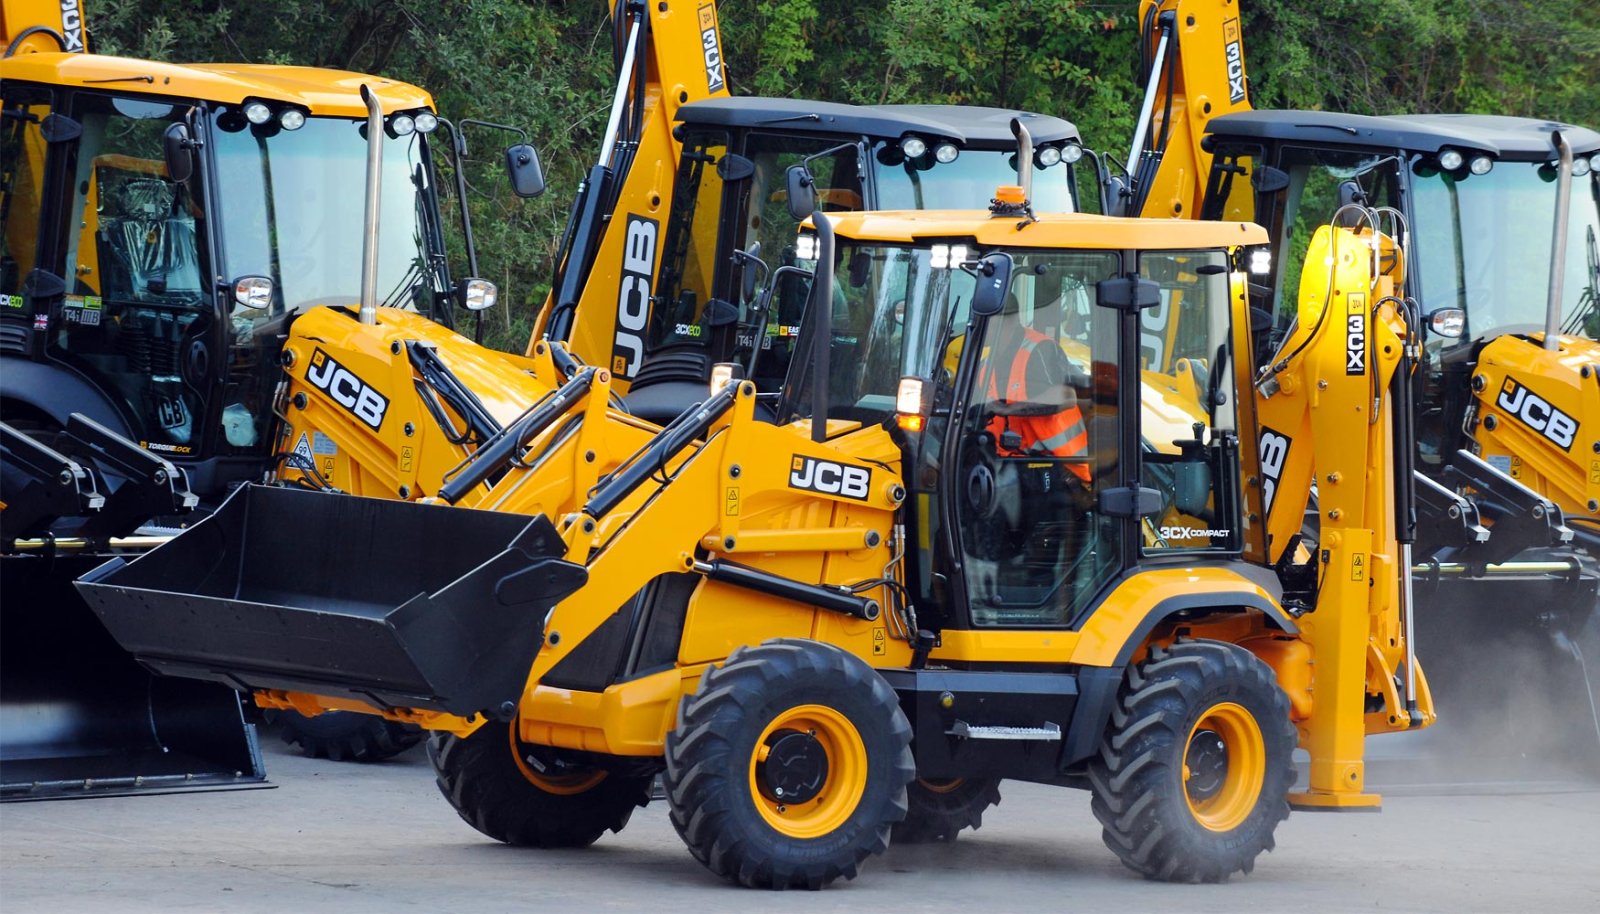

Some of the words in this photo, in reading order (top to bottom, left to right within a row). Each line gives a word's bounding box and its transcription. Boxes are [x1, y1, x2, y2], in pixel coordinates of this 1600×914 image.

[702, 28, 723, 86] 3CX
[1226, 42, 1244, 97] 3CX
[615, 219, 656, 378] JCB
[1347, 315, 1365, 367] 3CX
[308, 359, 386, 428] JCB
[1498, 386, 1577, 448] JCB
[790, 459, 869, 498] JCB
